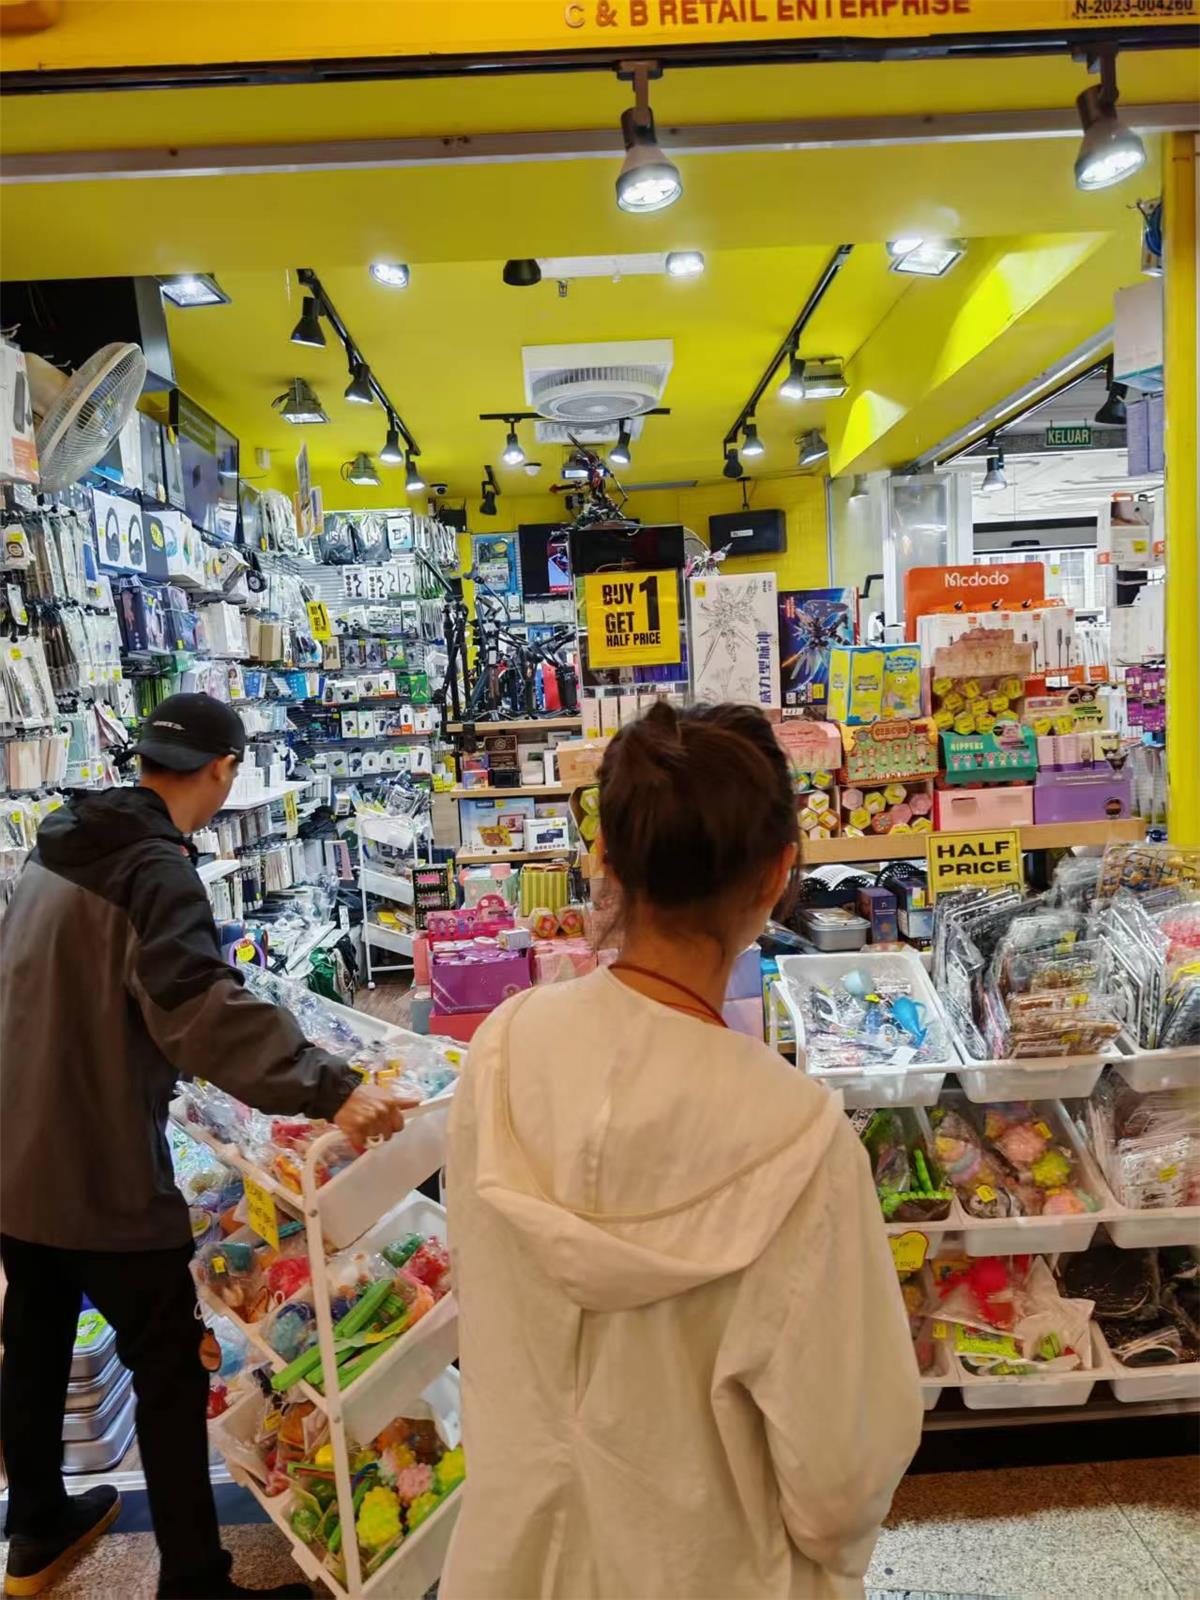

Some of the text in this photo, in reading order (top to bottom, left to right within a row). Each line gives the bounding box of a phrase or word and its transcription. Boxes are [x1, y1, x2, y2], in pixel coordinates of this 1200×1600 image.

[564, 3, 586, 28] C
[595, 2, 619, 27] &
[630, 2, 650, 27] B
[659, 0, 768, 26] RETAIL
[1048, 429, 1090, 444] KELUAR
[944, 571, 1010, 588] Mcdodo
[602, 575, 660, 631] BUY 1
[605, 611, 635, 633] GET
[606, 632, 661, 647] HALF PRICE
[936, 840, 1010, 859] HALF
[938, 860, 1012, 877] PRICE
